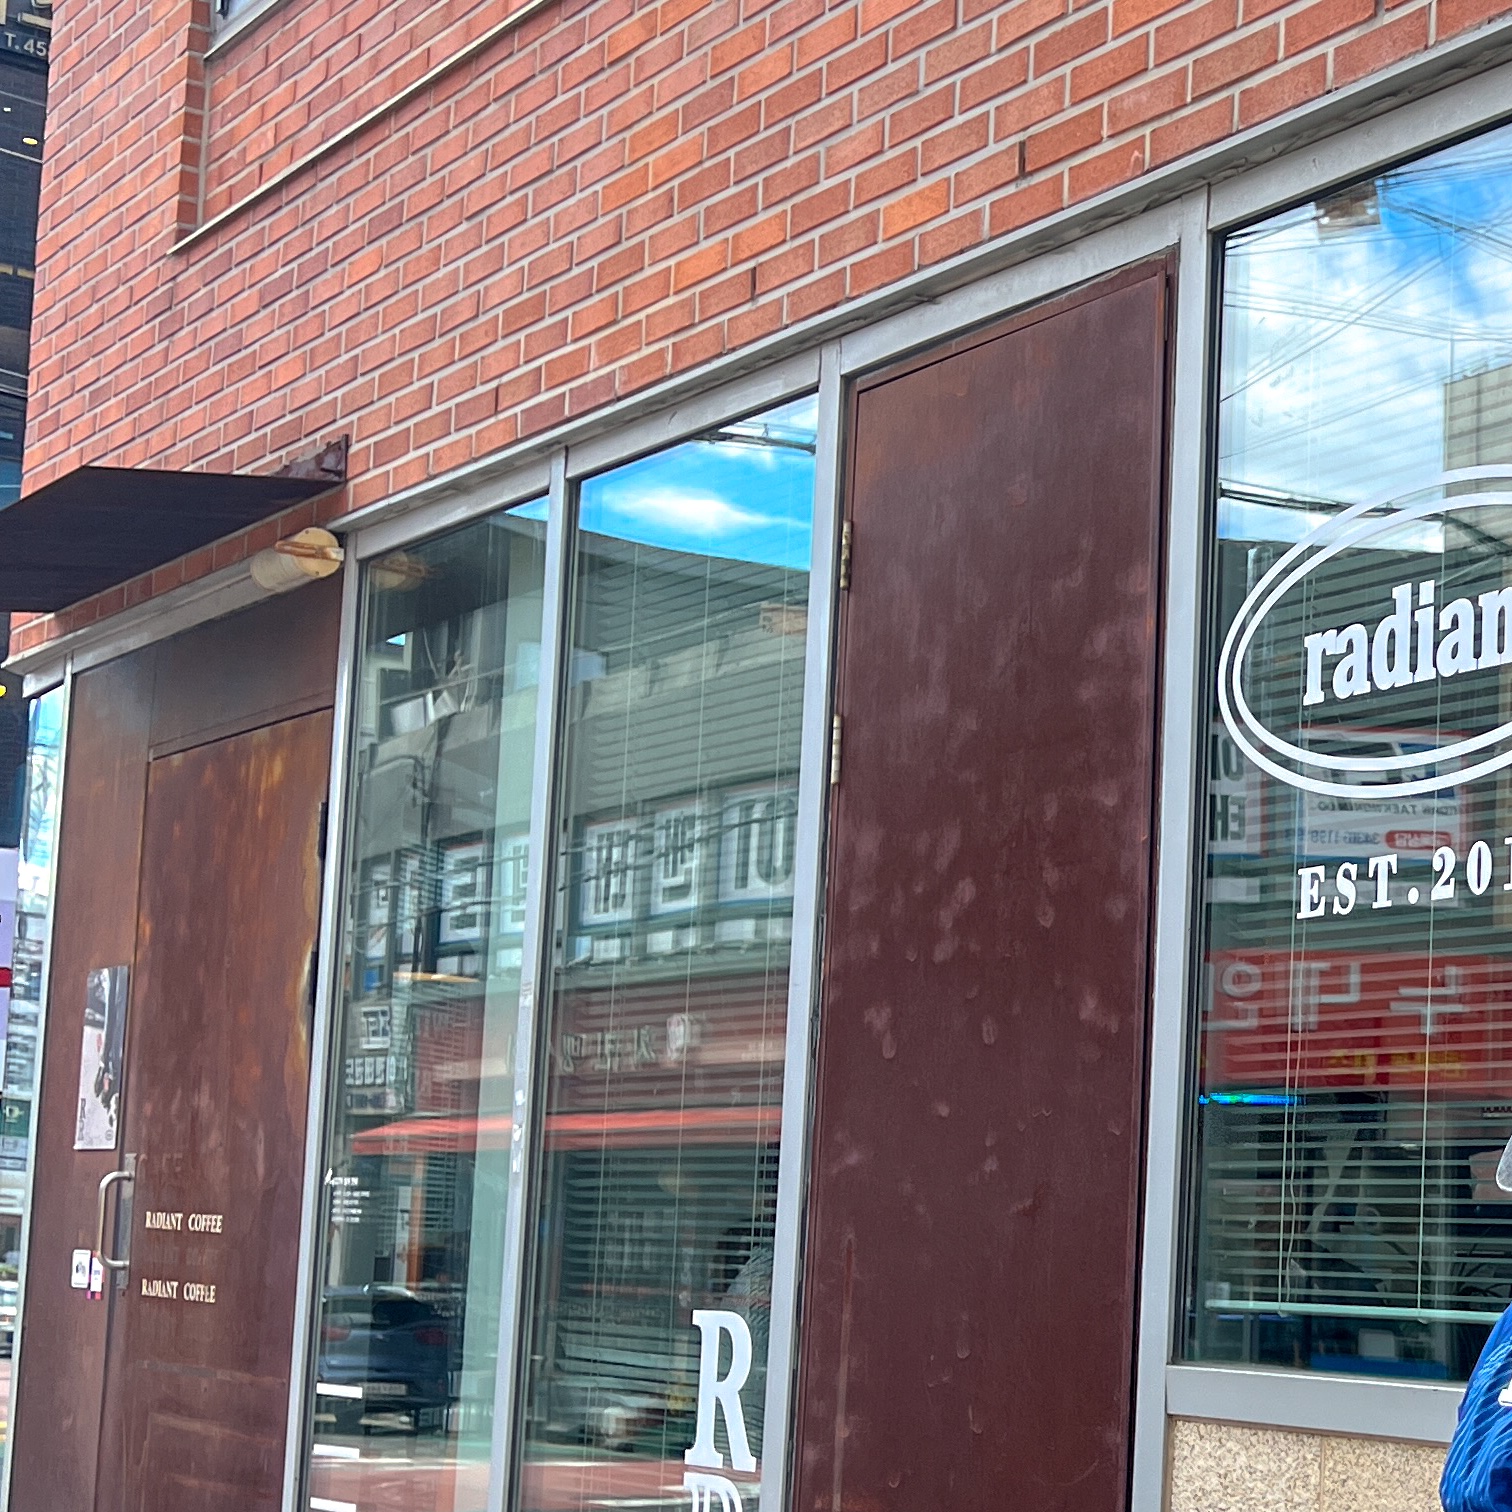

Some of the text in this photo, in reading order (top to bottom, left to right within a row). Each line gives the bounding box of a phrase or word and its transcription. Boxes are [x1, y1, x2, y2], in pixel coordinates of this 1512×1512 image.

[145, 1210, 224, 1235] RADIANT COFFEE
[141, 1278, 179, 1300] RADIANT
[684, 1309, 757, 1473] R
